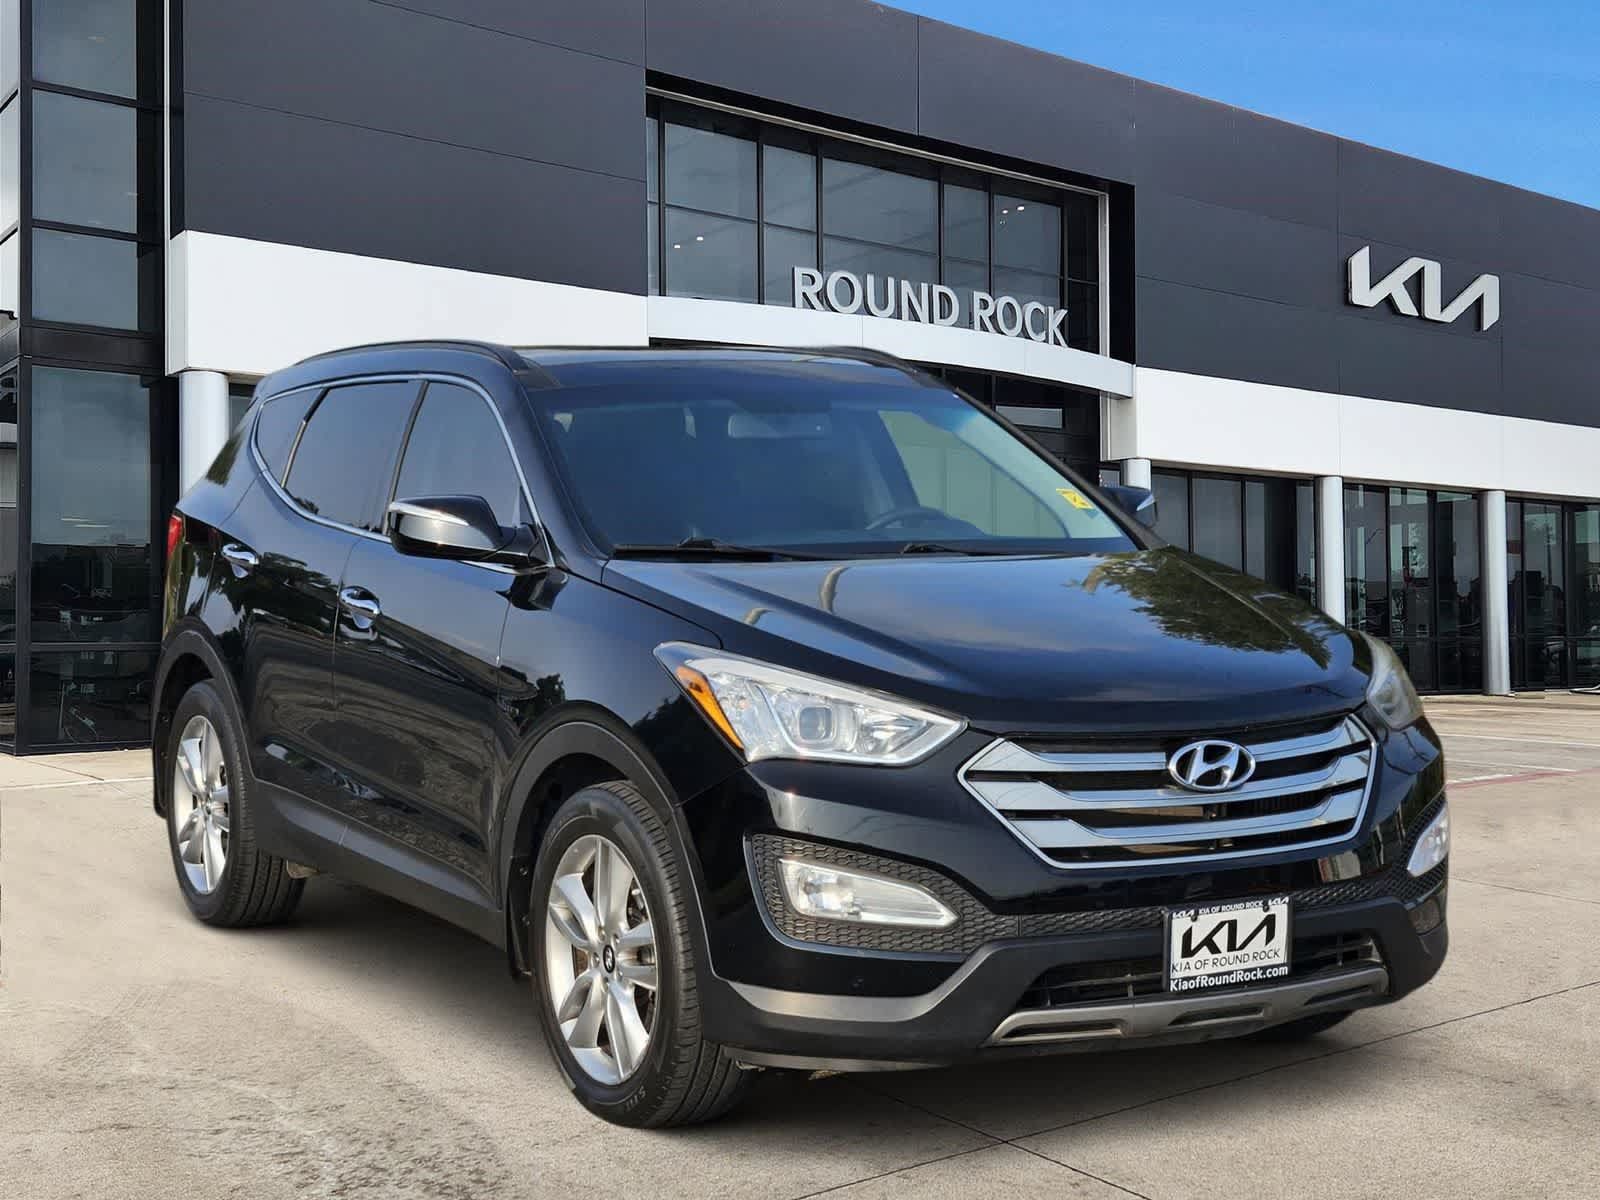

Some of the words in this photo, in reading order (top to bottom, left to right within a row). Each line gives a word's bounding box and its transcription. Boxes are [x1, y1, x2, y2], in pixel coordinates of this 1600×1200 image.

[1348, 245, 1499, 331] KIA
[792, 266, 960, 326] ROUND
[973, 290, 1069, 348] ROCK
[1211, 905, 1220, 913] OF
[1222, 903, 1245, 912] ROUND
[1246, 900, 1264, 908] ROCK
[1181, 913, 1276, 959] KIA
[1170, 966, 1288, 992] KiaofRoundRock.com
[1171, 960, 1191, 974] KIA
[1194, 958, 1209, 970] OF
[1212, 953, 1250, 967] ROUND
[1252, 949, 1280, 962] ROCK
